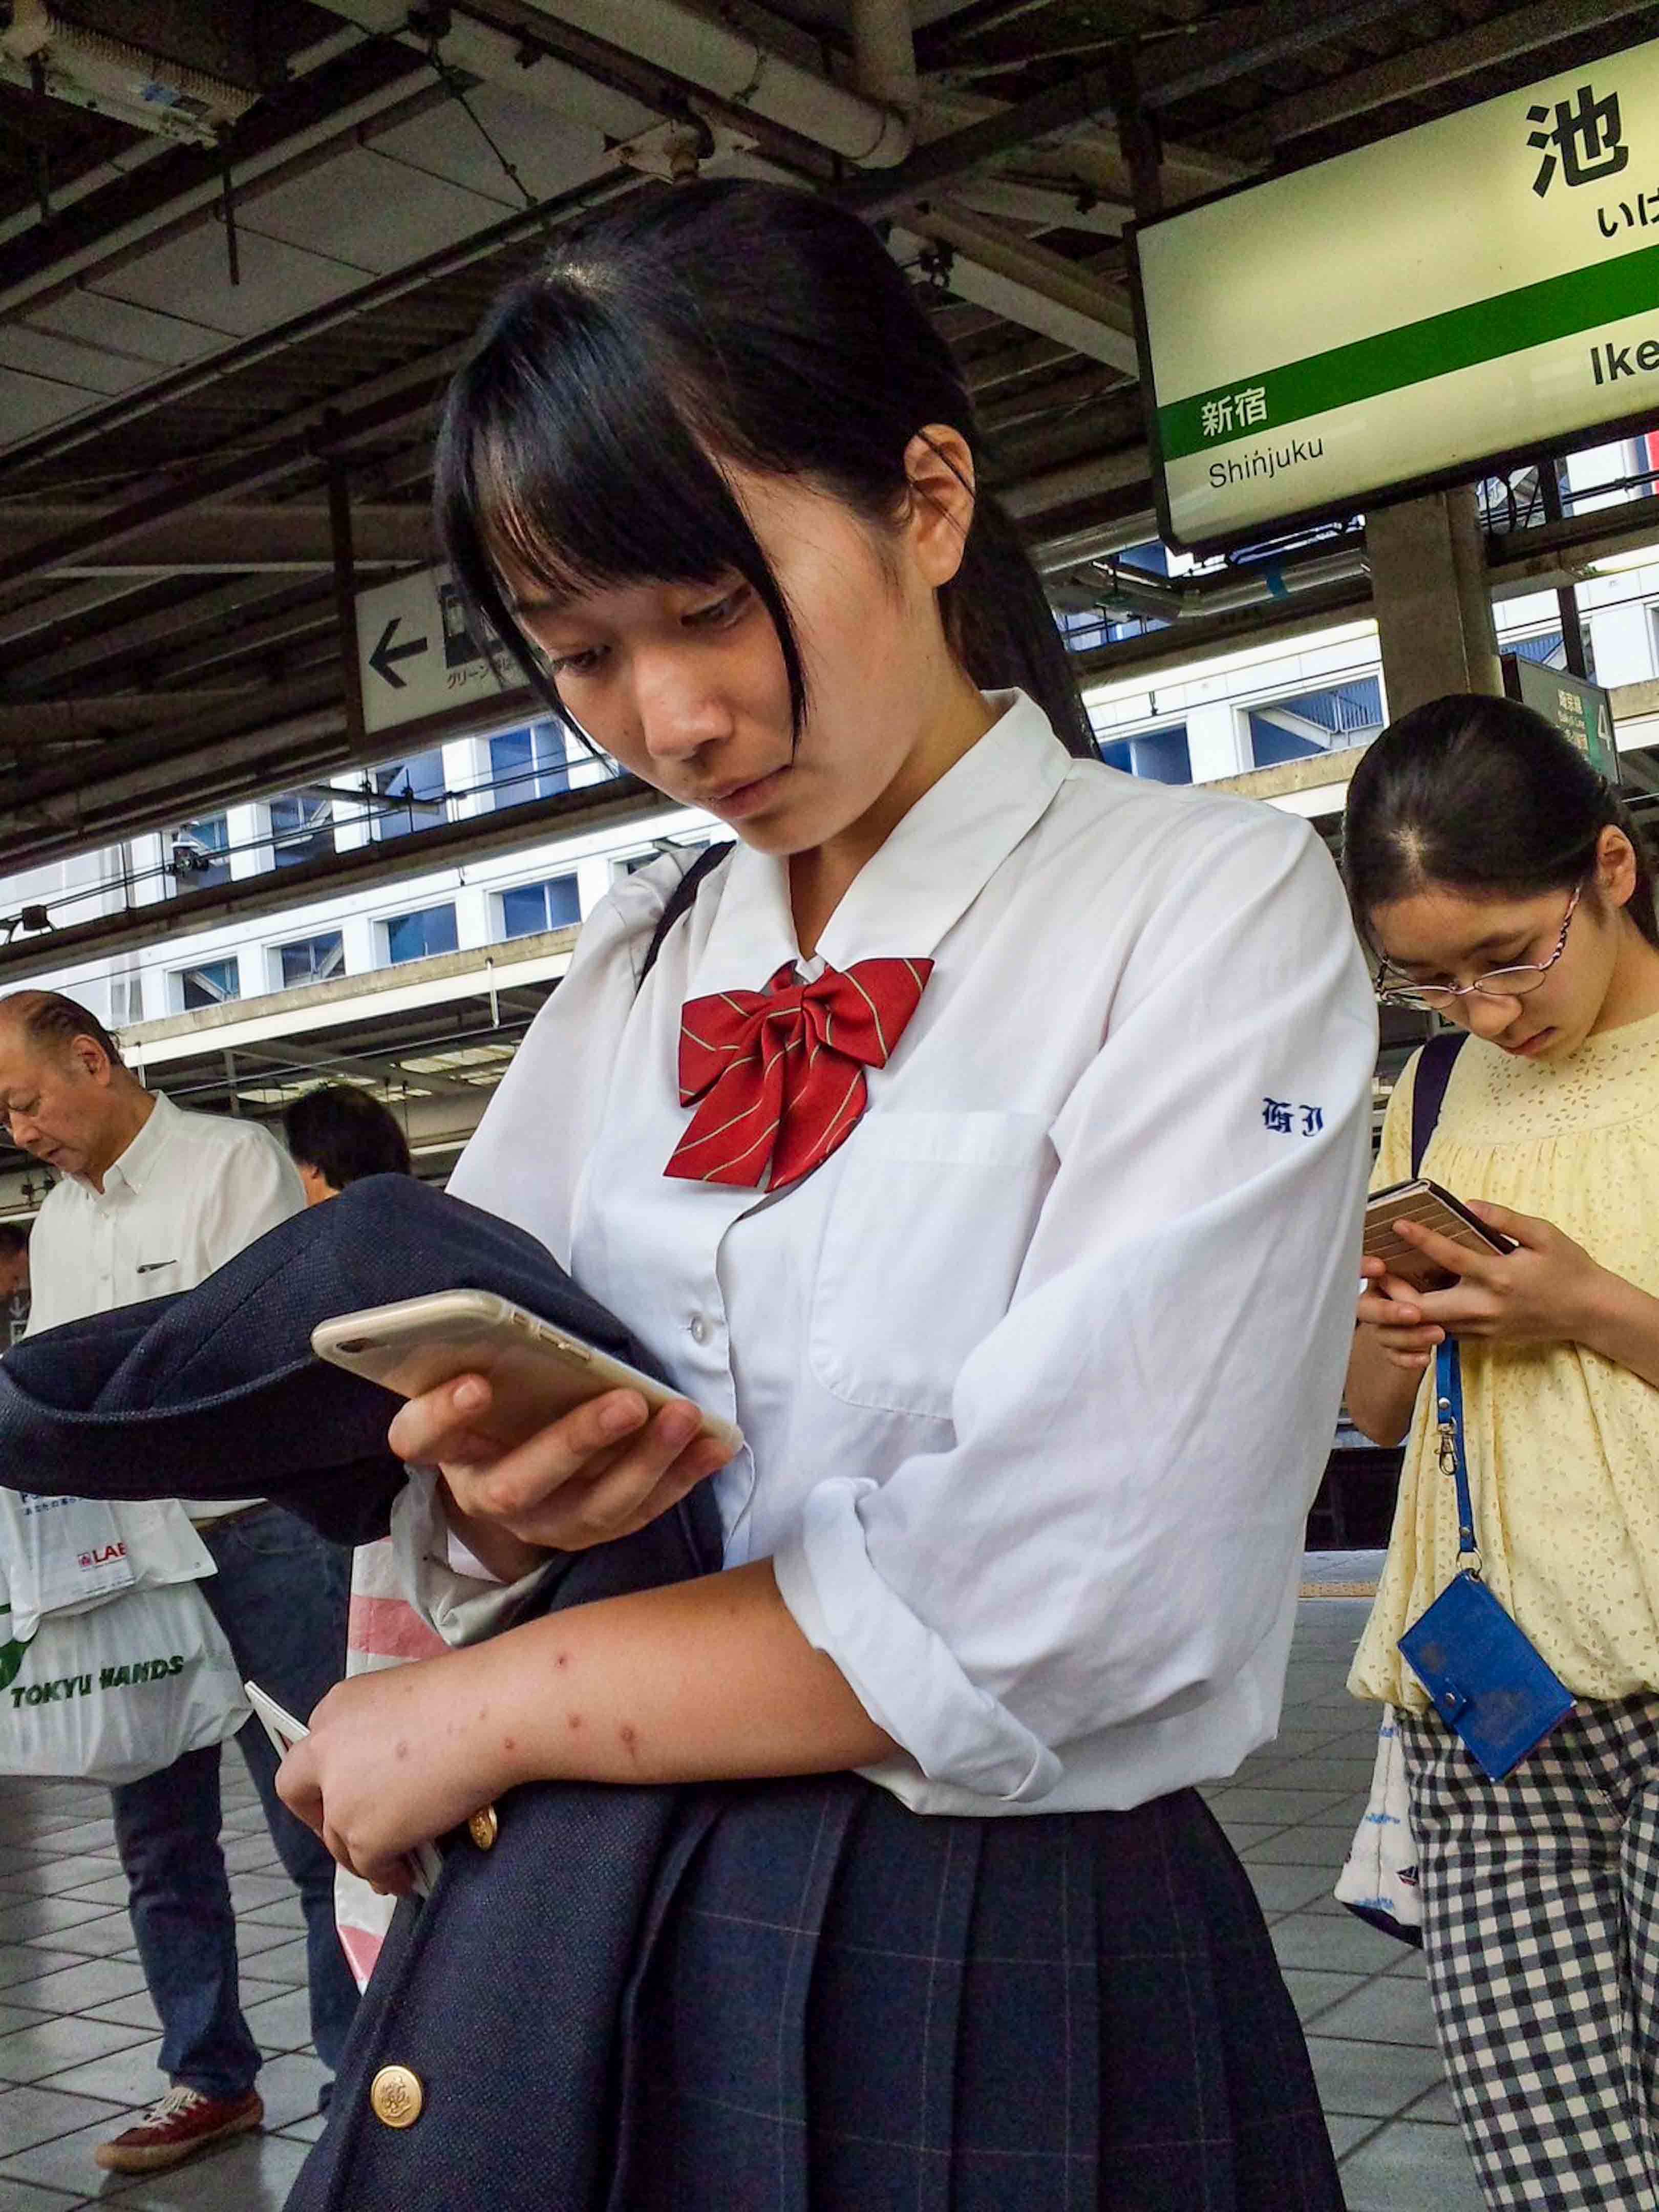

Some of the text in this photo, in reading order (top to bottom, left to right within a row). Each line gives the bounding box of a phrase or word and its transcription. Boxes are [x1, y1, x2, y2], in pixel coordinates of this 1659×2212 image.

[1526, 84, 1629, 198] 池
[1590, 339, 1659, 385] Ike
[1201, 387, 1268, 437] 新宿
[1209, 438, 1323, 488] Shinjuku
[1597, 704, 1611, 750] 4
[11, 1655, 184, 1708] TOKYU HANDS
